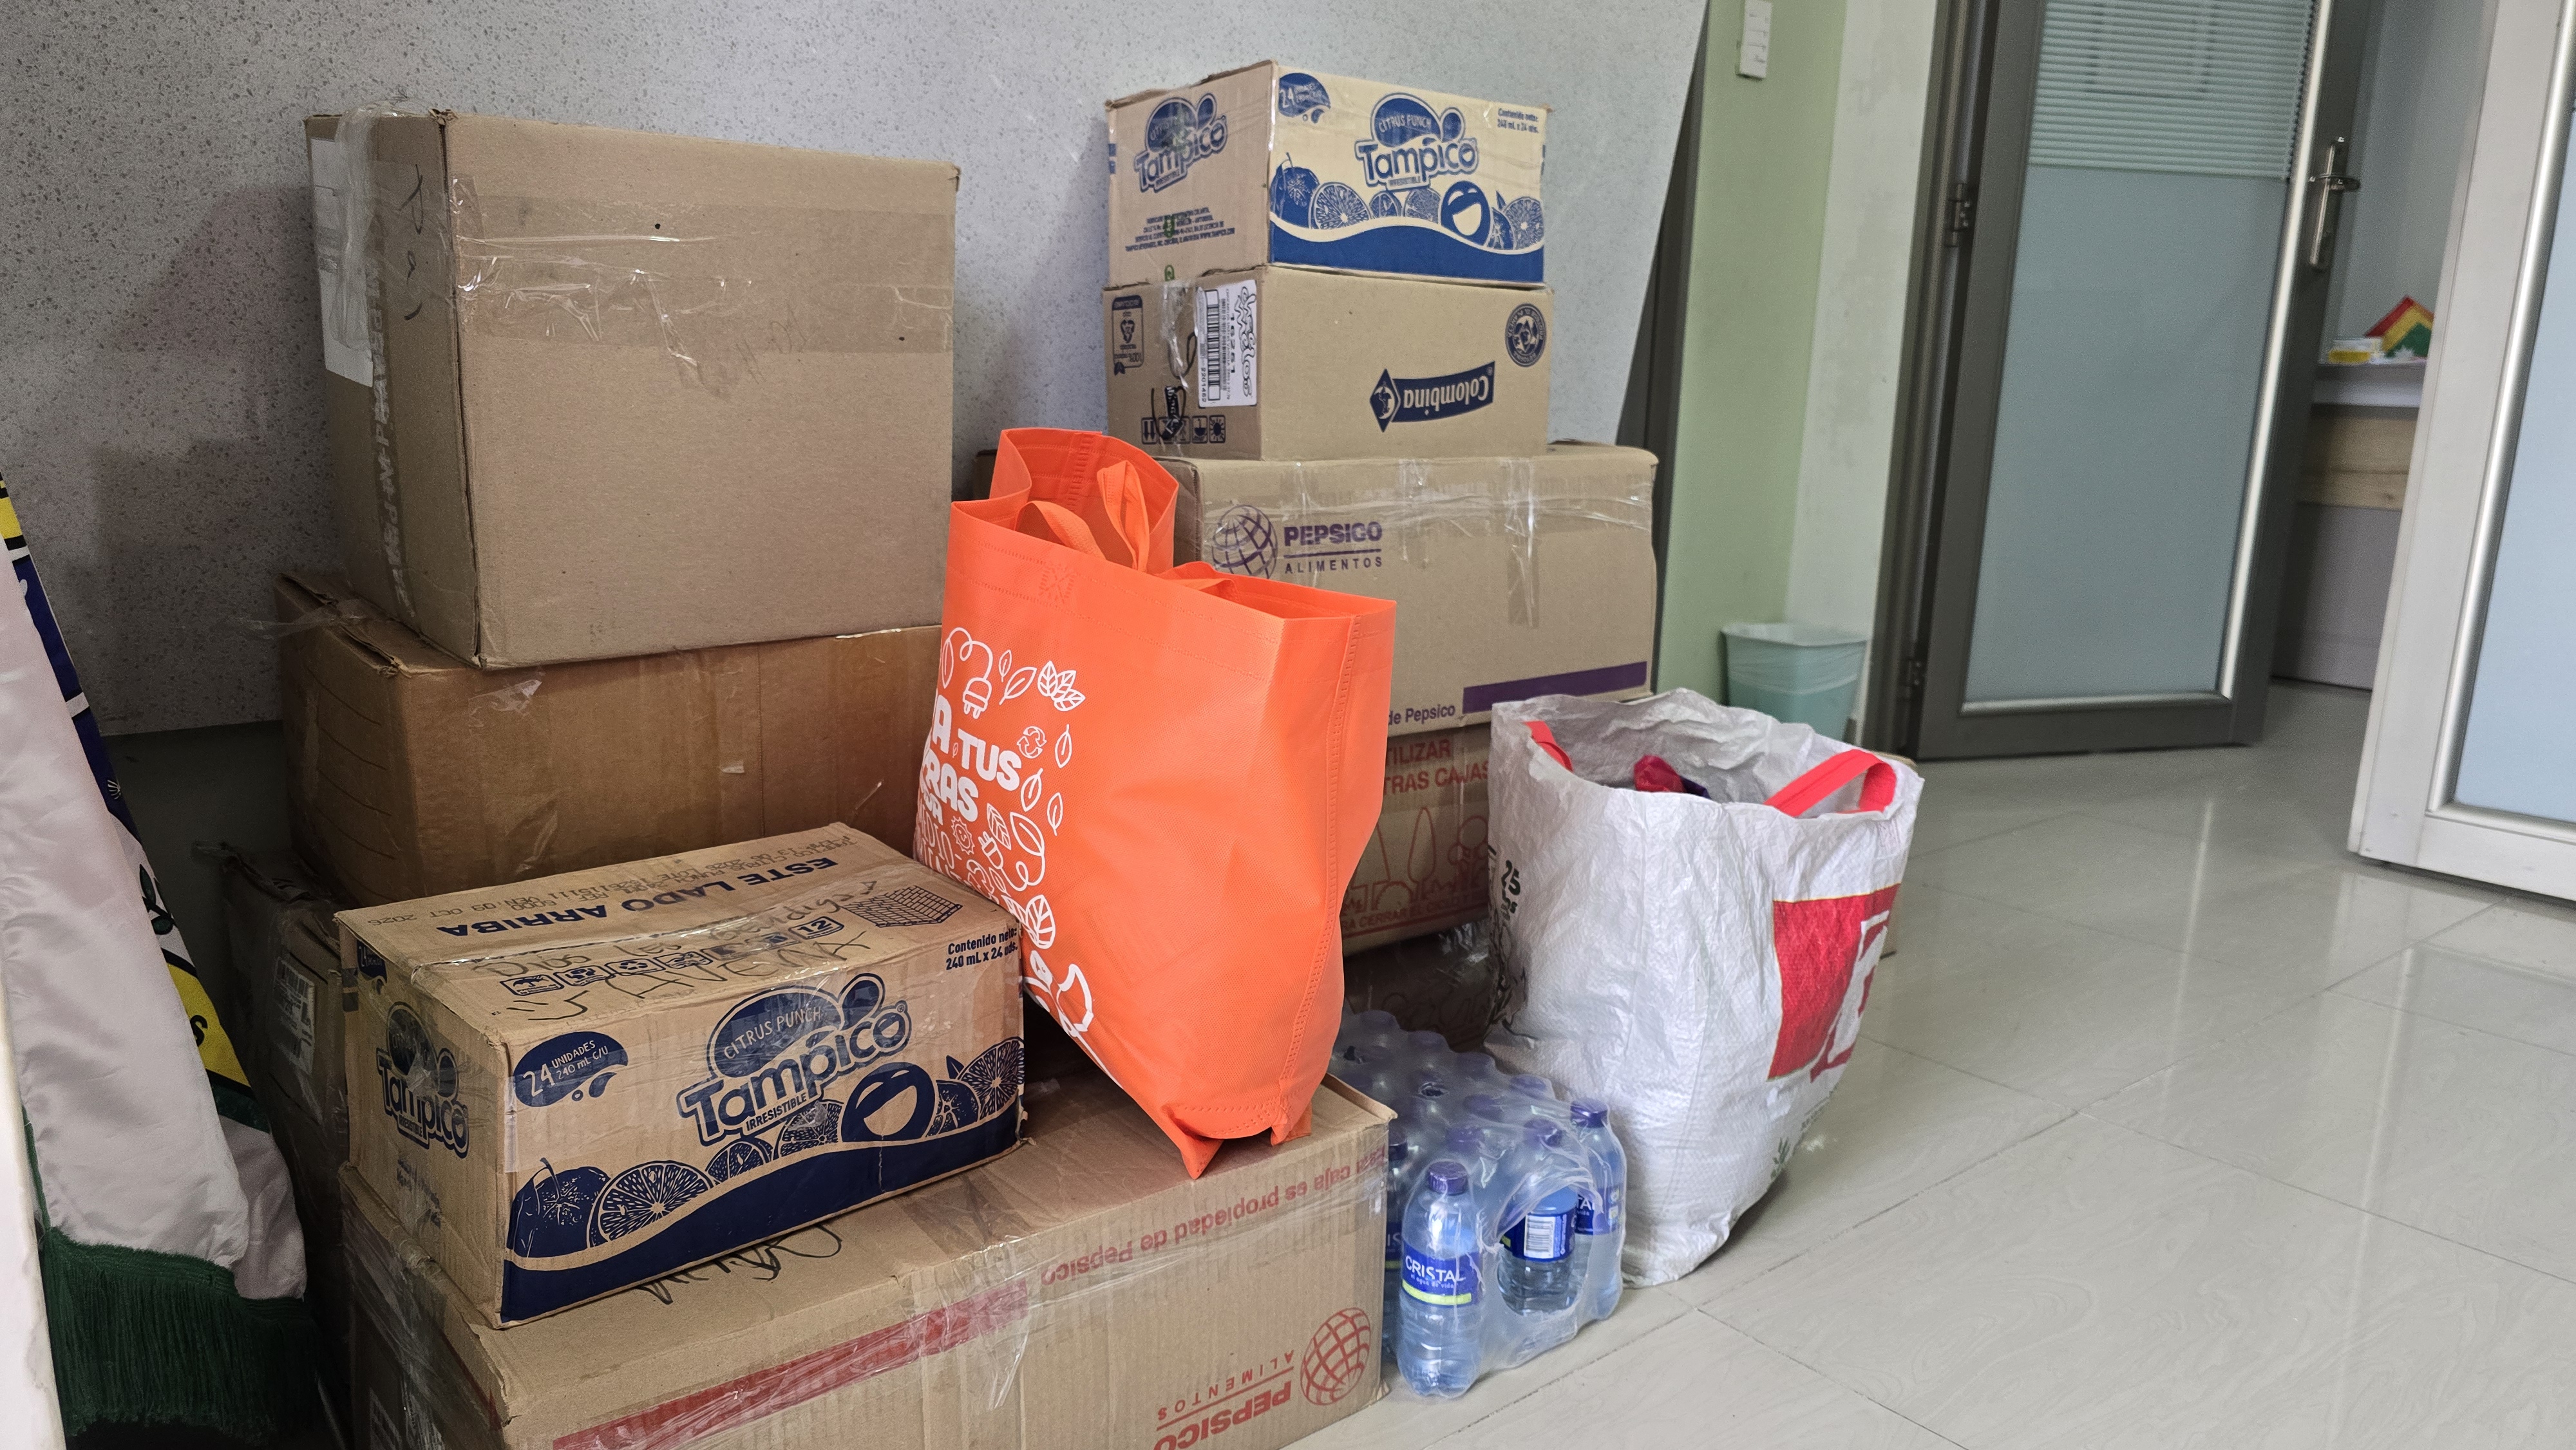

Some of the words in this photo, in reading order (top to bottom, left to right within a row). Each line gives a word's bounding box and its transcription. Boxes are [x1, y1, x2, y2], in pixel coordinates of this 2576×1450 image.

[1378, 115, 1405, 133] CITRUS
[1135, 121, 1225, 187] Tampico
[1358, 138, 1476, 183] Tampico
[1403, 375, 1490, 416] Colombina
[1283, 521, 1383, 547] PEPSICO
[1285, 556, 1383, 574] ALIMENTOS
[1405, 704, 1456, 724] Pepsico
[958, 728, 1022, 791] TUS
[654, 867, 703, 881] LOTE
[737, 857, 839, 886] ESTE
[1501, 860, 1521, 896] 25
[621, 880, 735, 912] LADO
[366, 914, 419, 926] 2026
[424, 907, 466, 918] OCT
[436, 905, 608, 937] ARRIBA
[798, 919, 833, 934] 12
[945, 955, 965, 971] 240
[966, 951, 982, 966] mL
[983, 951, 989, 962] x
[990, 945, 1003, 960] 24
[1004, 941, 1018, 956] uds.
[947, 934, 997, 956] Contenido
[998, 927, 1018, 943] neto:
[723, 1020, 773, 1060] CITRUS
[776, 1005, 822, 1031] PUNCH
[551, 1040, 596, 1069] UNIDADES
[556, 1064, 576, 1080] 240
[577, 1056, 592, 1069] mL
[592, 1045, 609, 1060] C/U
[522, 1063, 556, 1097] 24
[684, 1012, 906, 1137] Tampico
[378, 1052, 469, 1150] Tampico
[746, 1091, 808, 1131] IRRESISTIBLE
[1285, 1182, 1309, 1201] es
[1314, 1164, 1350, 1191] caja
[1174, 1185, 1280, 1245] propiedad
[1140, 1229, 1168, 1252] de
[1039, 1240, 1133, 1286] Pepsico
[1405, 1255, 1466, 1283] CRISTAL
[1157, 1349, 1294, 1421] ALIMENTOS
[1153, 1380, 1292, 1450] PEPSICO
